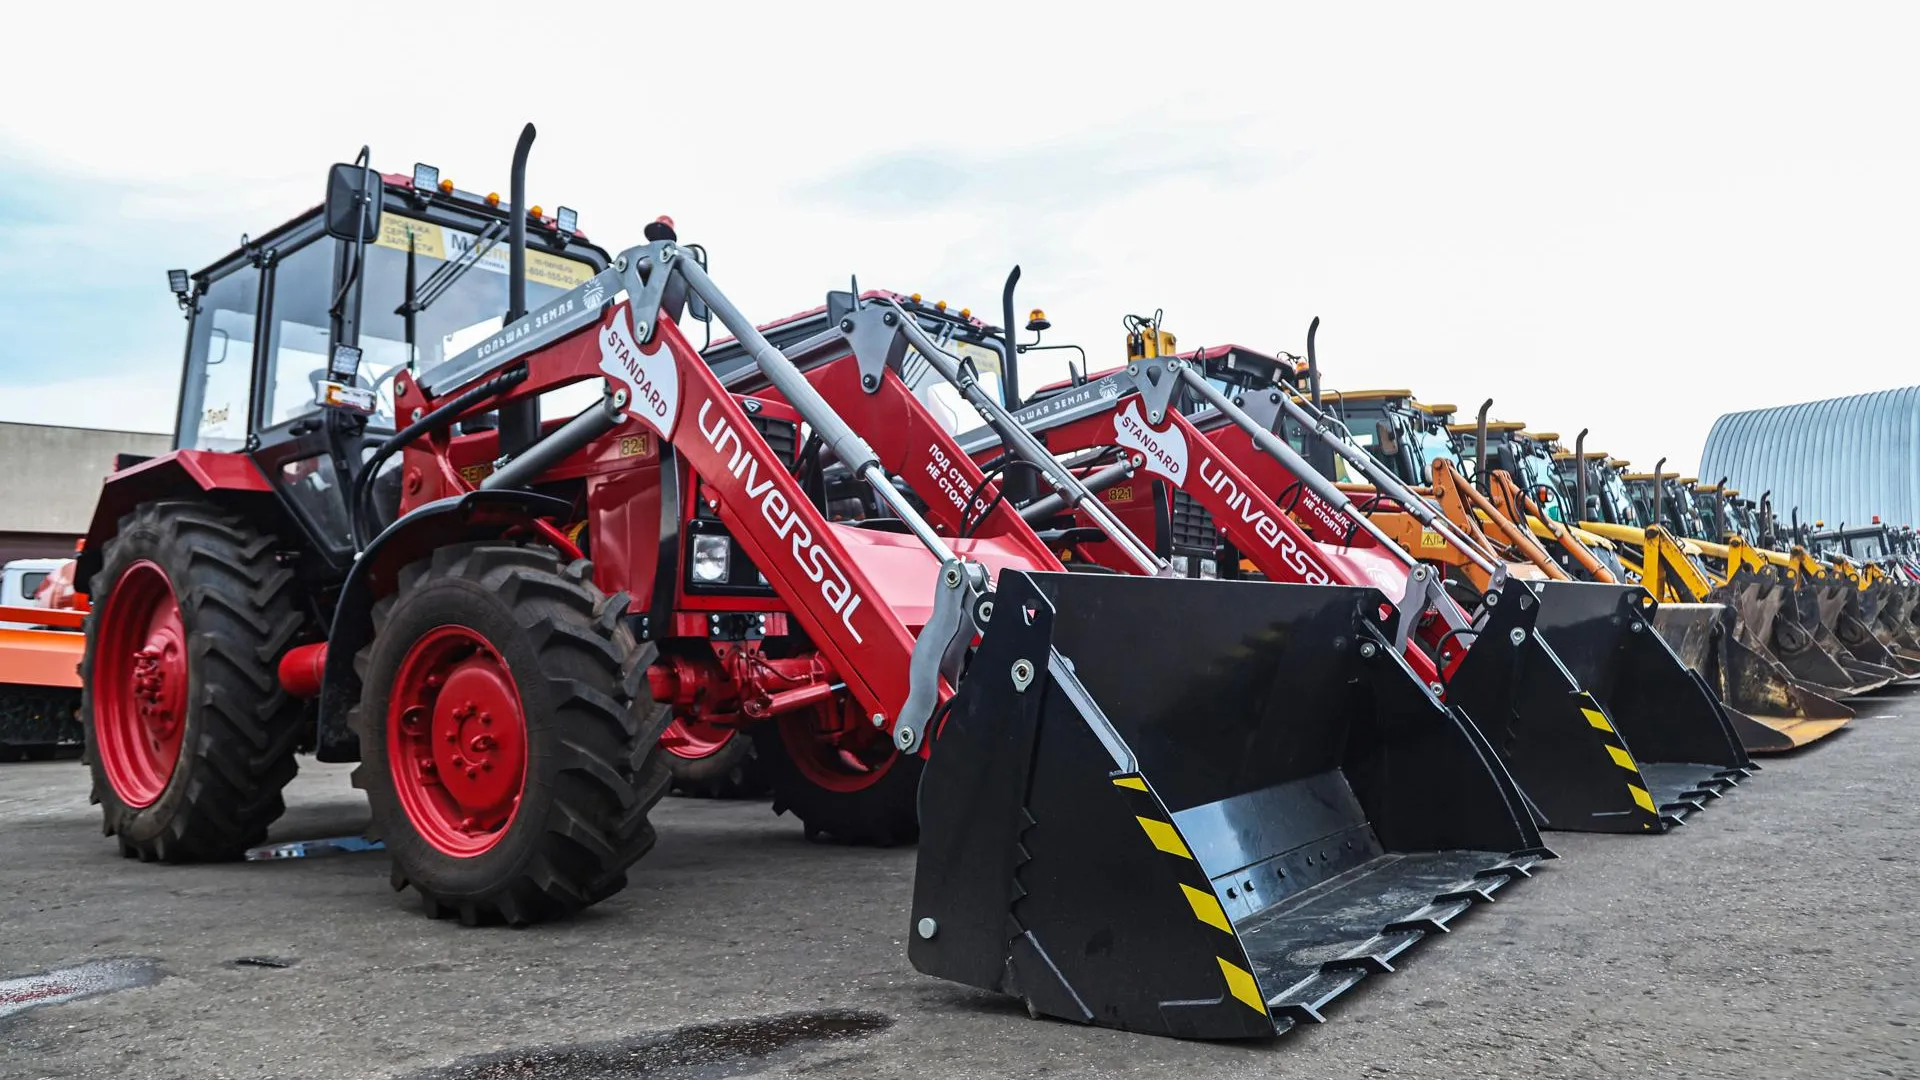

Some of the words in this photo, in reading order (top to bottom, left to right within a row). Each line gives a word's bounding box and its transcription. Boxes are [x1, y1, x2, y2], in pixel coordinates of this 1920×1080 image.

[477, 323, 530, 359] БОЛЬШАЯ
[535, 299, 574, 328] ЗЕМЛЯ
[608, 331, 668, 418] STANDARD
[1054, 391, 1091, 410] ЗЕМЛЯ
[925, 463, 938, 480] НЕ
[1121, 416, 1180, 474] STANDARD
[928, 443, 952, 472] ПОД
[950, 468, 991, 515] СТРЕОЙ
[1199, 456, 1337, 586] UNIVERSA
[1303, 496, 1316, 511] НЕ
[1314, 507, 1342, 537] СТОЯТЬ
